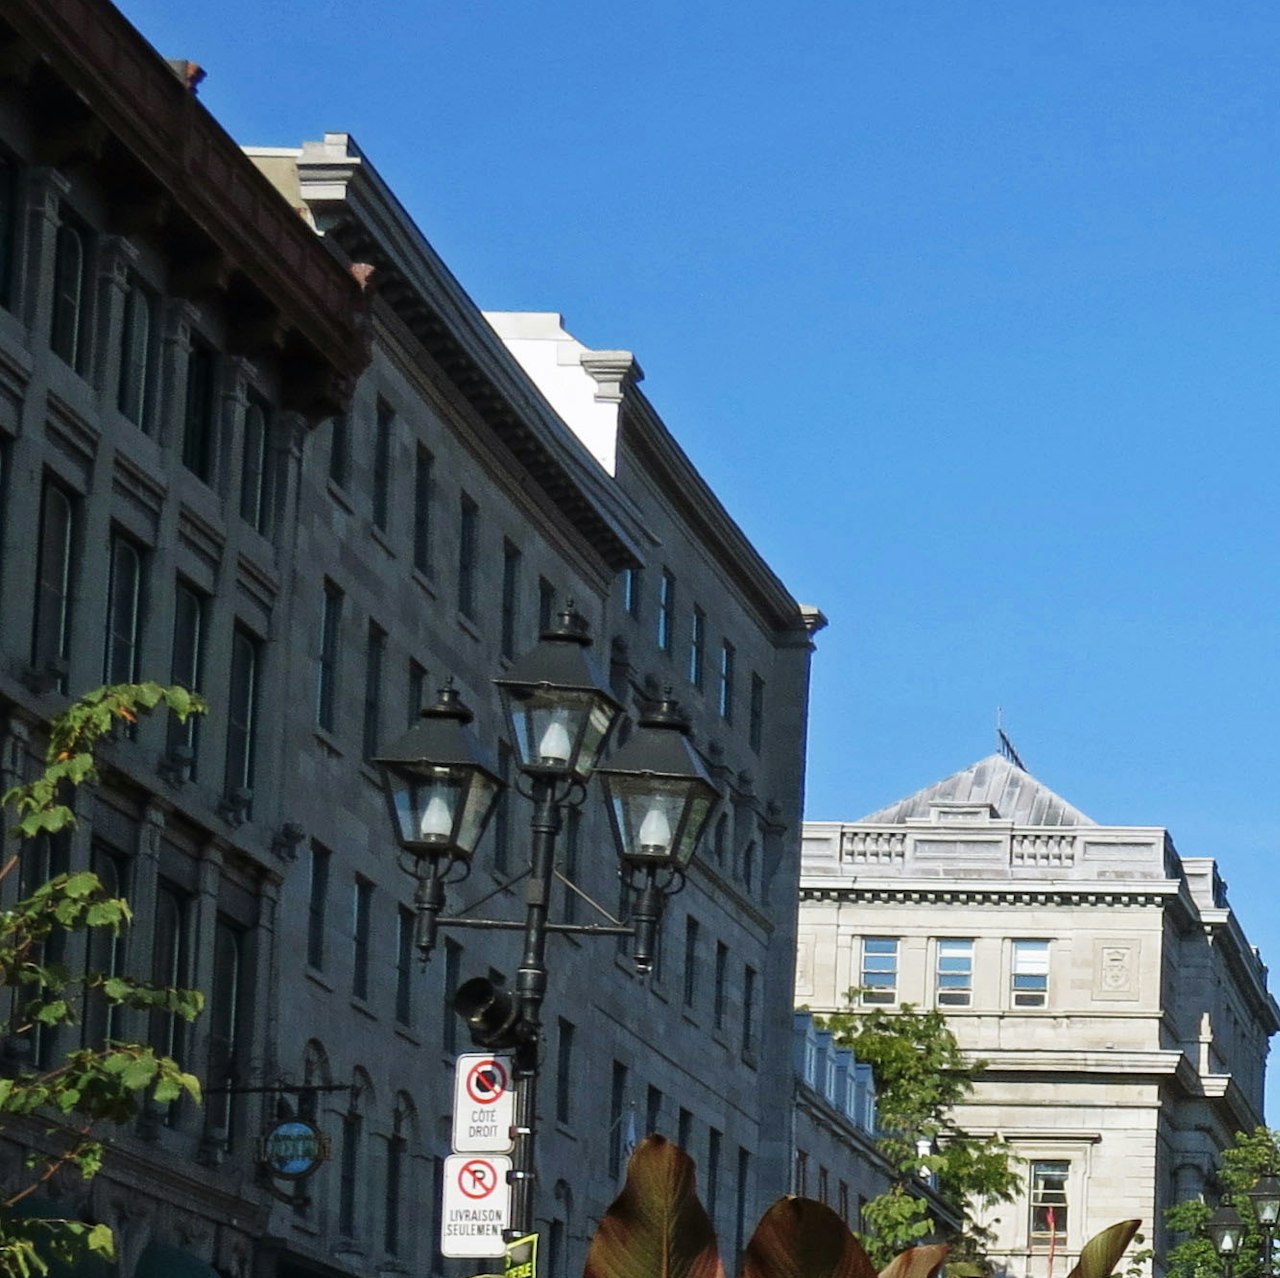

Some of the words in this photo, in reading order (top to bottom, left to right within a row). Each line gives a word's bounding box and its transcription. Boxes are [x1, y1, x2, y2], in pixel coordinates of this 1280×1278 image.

[468, 1124, 498, 1138] DROIT
[449, 1209, 503, 1222] LIVRAISON
[446, 1223, 505, 1236] SEULEMENT
